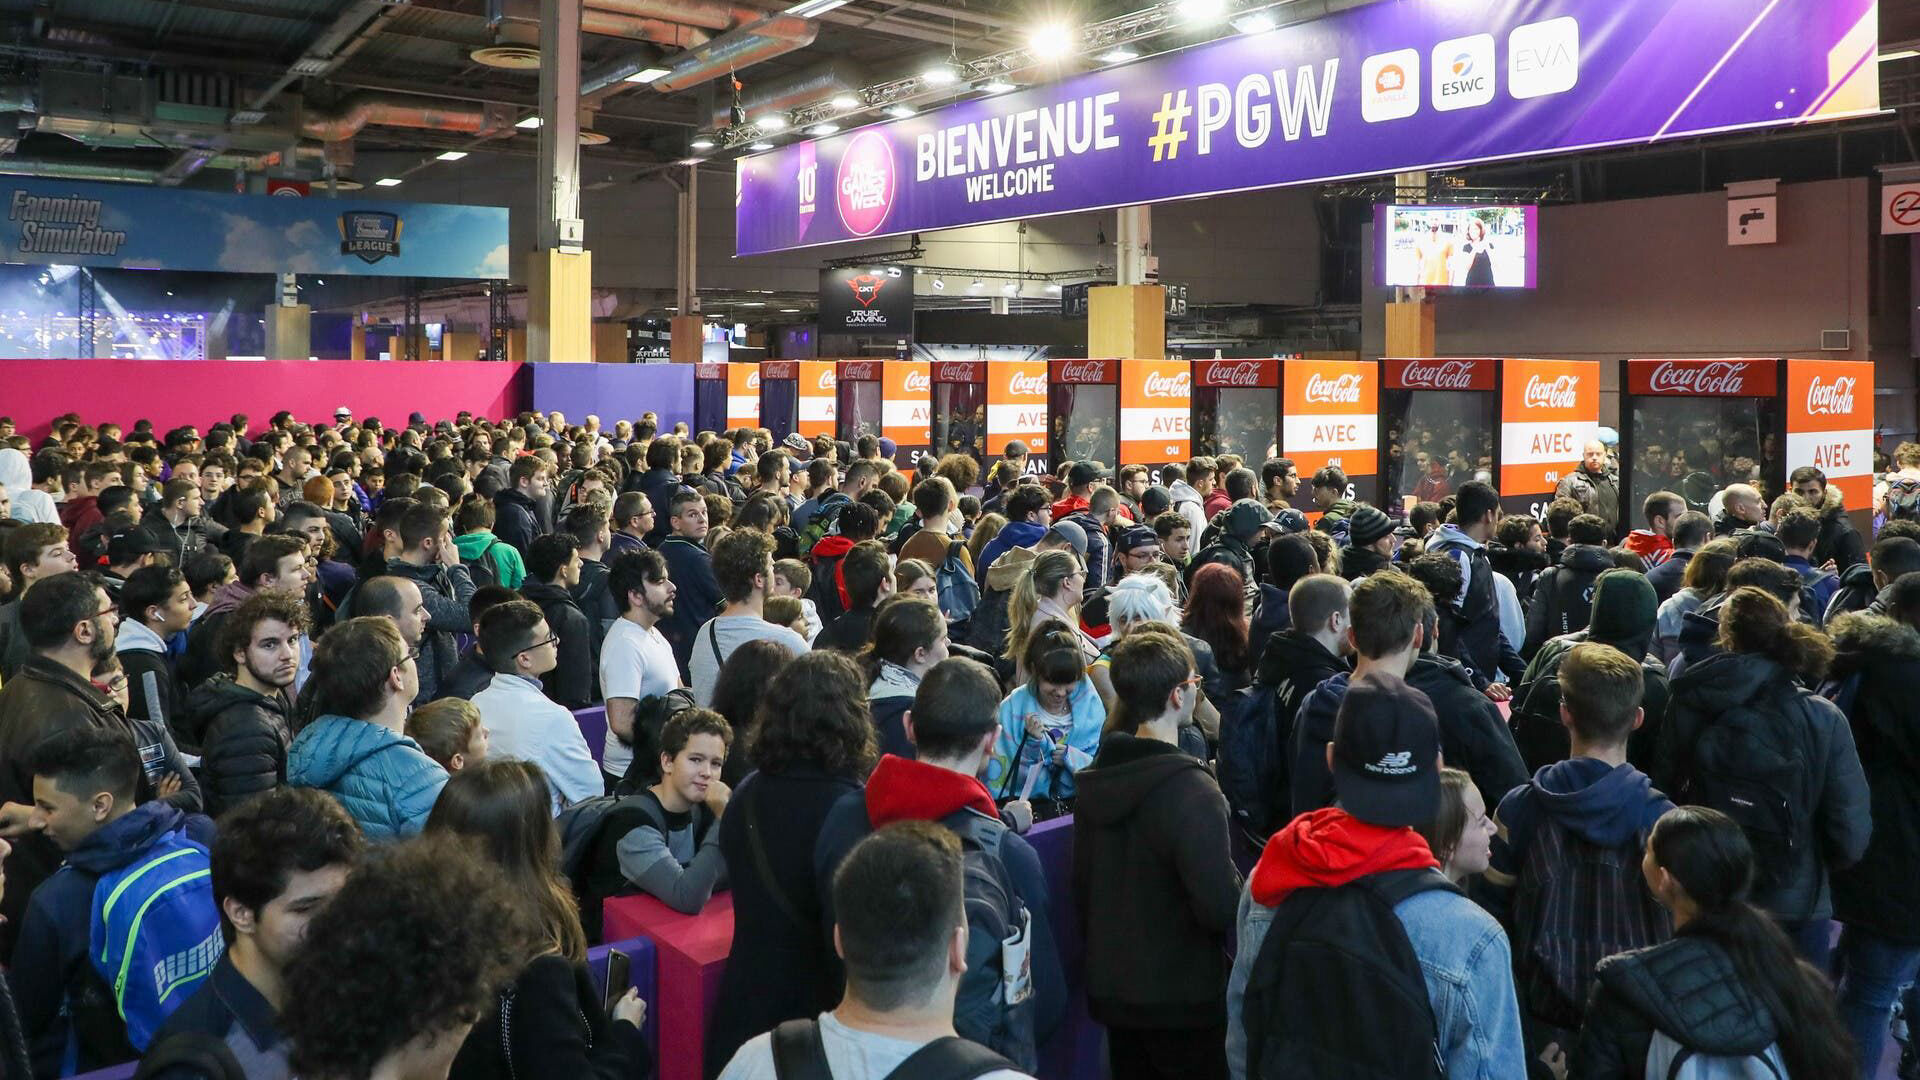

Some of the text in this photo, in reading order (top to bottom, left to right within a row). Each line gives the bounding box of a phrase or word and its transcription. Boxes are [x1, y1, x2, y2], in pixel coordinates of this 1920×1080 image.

[1442, 77, 1484, 96] ESWC
[1148, 58, 1340, 162] #PGW
[917, 91, 1120, 182] BIENVENUE
[966, 164, 1055, 203] WELCOME
[8, 189, 102, 229] Farming
[851, 185, 886, 210] WEEK
[19, 221, 127, 256] Simulator
[348, 241, 393, 252] LEAGUE
[940, 362, 975, 381] Coca-Cola
[1061, 361, 1105, 382] Coca-Cola
[1207, 361, 1263, 385] Coca-Cola
[1401, 360, 1476, 388] Coca-Cola
[1650, 361, 1750, 394] Coca-Cola
[1306, 373, 1363, 403] Coca-Cola
[1524, 375, 1580, 408] Coca-Cola
[1807, 375, 1857, 415] Coca-Cola
[1031, 439, 1044, 447] ou
[1313, 424, 1357, 443] AVEC
[1531, 433, 1573, 454] AVEC
[1165, 446, 1179, 455] ou
[1814, 443, 1851, 468] AVEC
[1545, 471, 1558, 482] ou
[1364, 763, 1417, 775] new balance
[153, 921, 225, 997] PUMA
